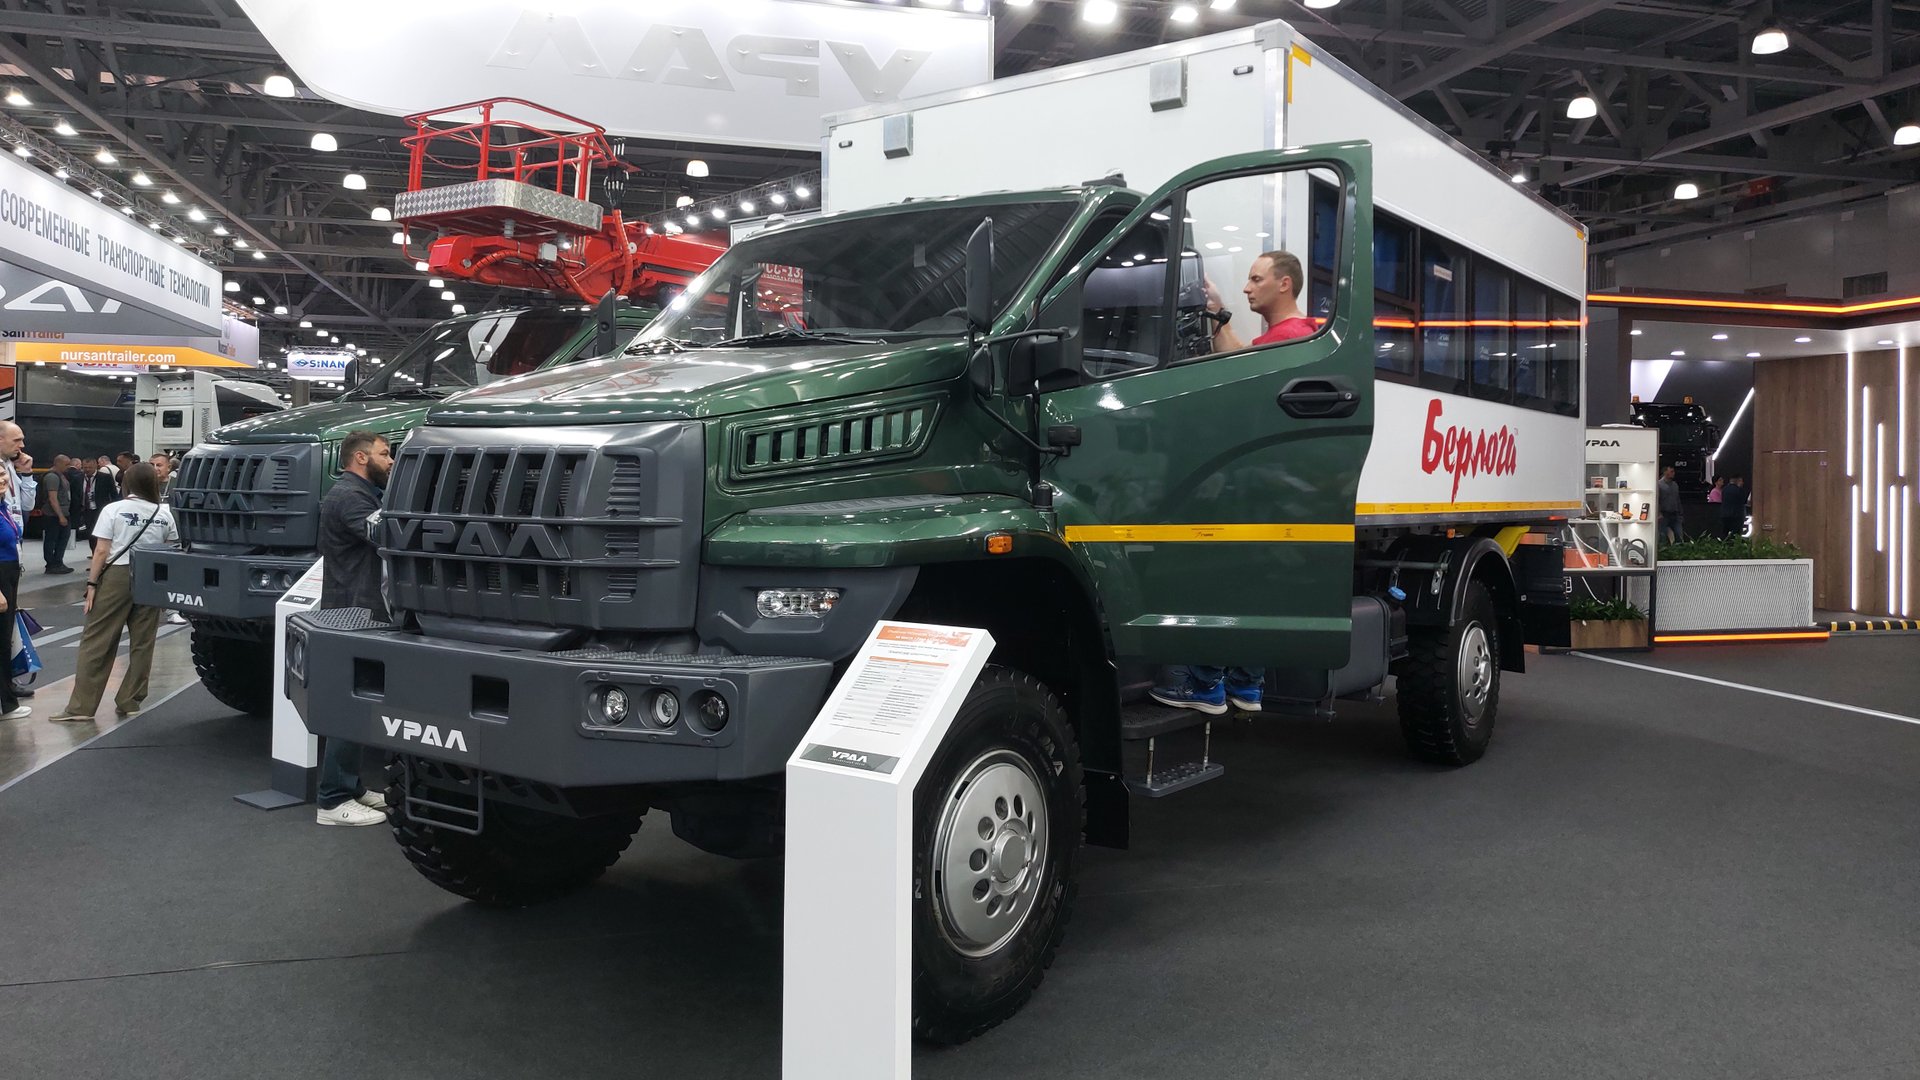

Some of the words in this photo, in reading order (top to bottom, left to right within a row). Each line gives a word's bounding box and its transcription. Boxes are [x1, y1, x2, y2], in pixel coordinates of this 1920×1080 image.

[1, 188, 91, 257] СОВРЕМЕННЫЕ
[97, 233, 165, 289] ТРАНСПОРТНЫЕ
[169, 269, 211, 308] ТЕХНОЛОГИИ
[60, 350, 176, 364] nursantrailer.com
[1421, 398, 1517, 505] Берлога
[387, 518, 563, 559] УРАЛ
[167, 591, 204, 607] УРАЛ
[381, 715, 468, 753] УРАЛ
[832, 750, 868, 763] УРАЛ
